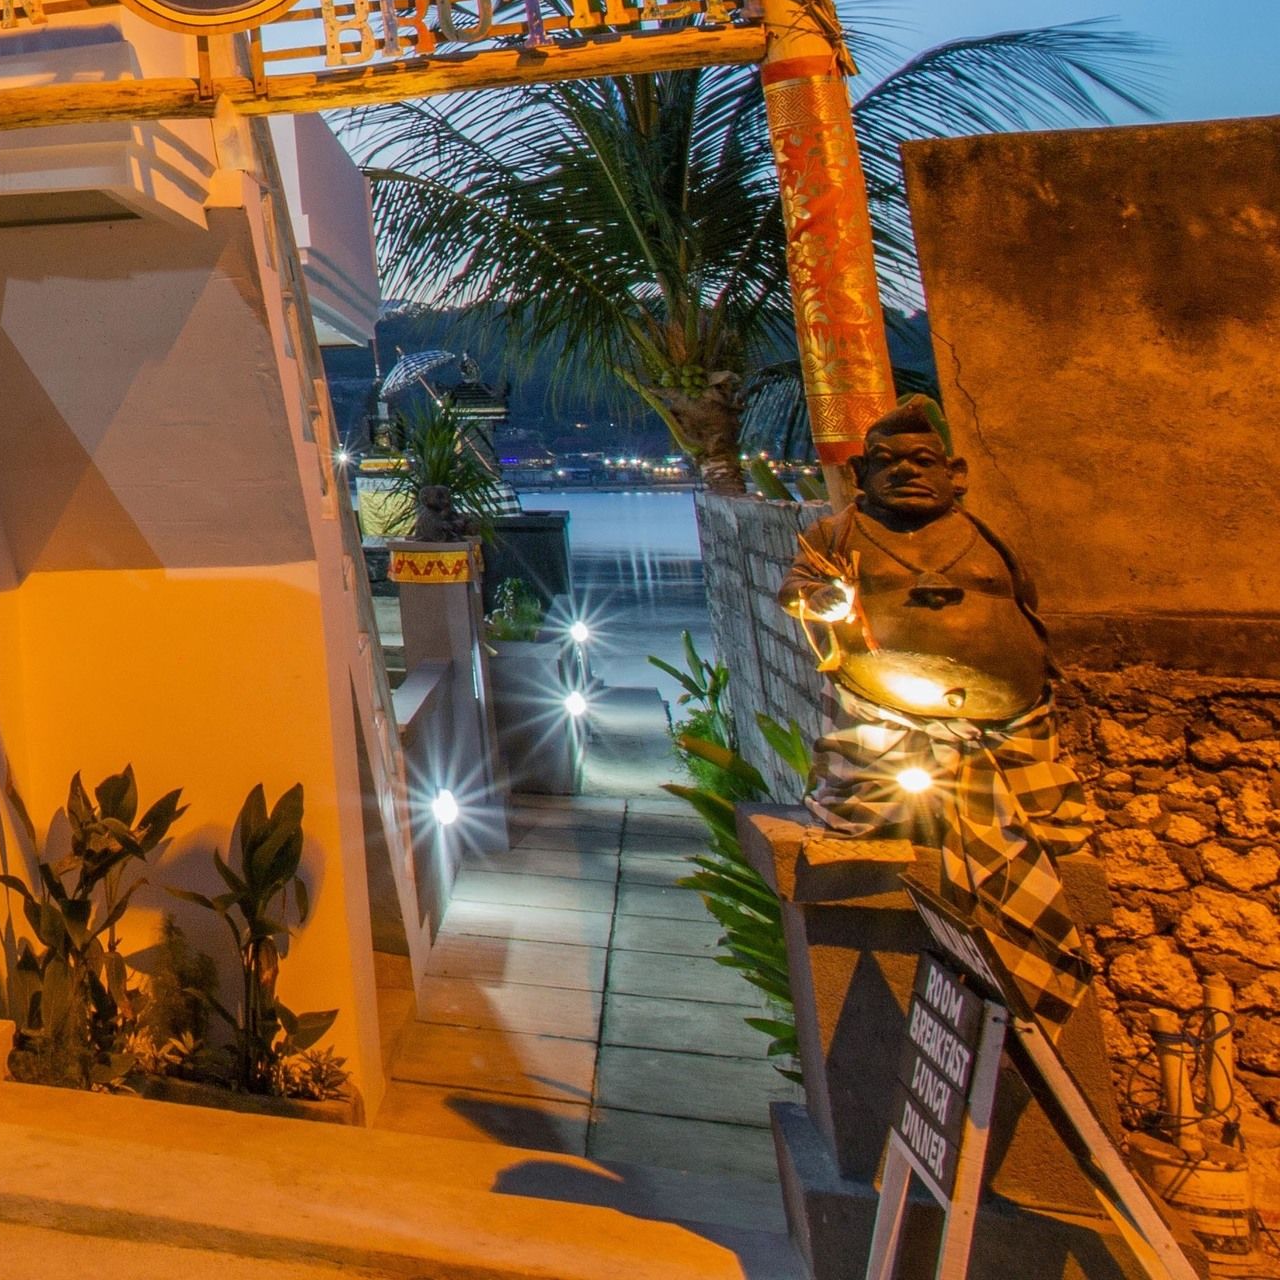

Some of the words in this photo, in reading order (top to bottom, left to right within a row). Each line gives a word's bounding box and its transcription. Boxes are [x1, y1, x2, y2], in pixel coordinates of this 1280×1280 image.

[925, 964, 964, 1027] ROOM
[910, 1001, 971, 1088] BREAKFAST
[911, 1056, 951, 1125] LUNCH
[901, 1100, 947, 1180] DINNER
